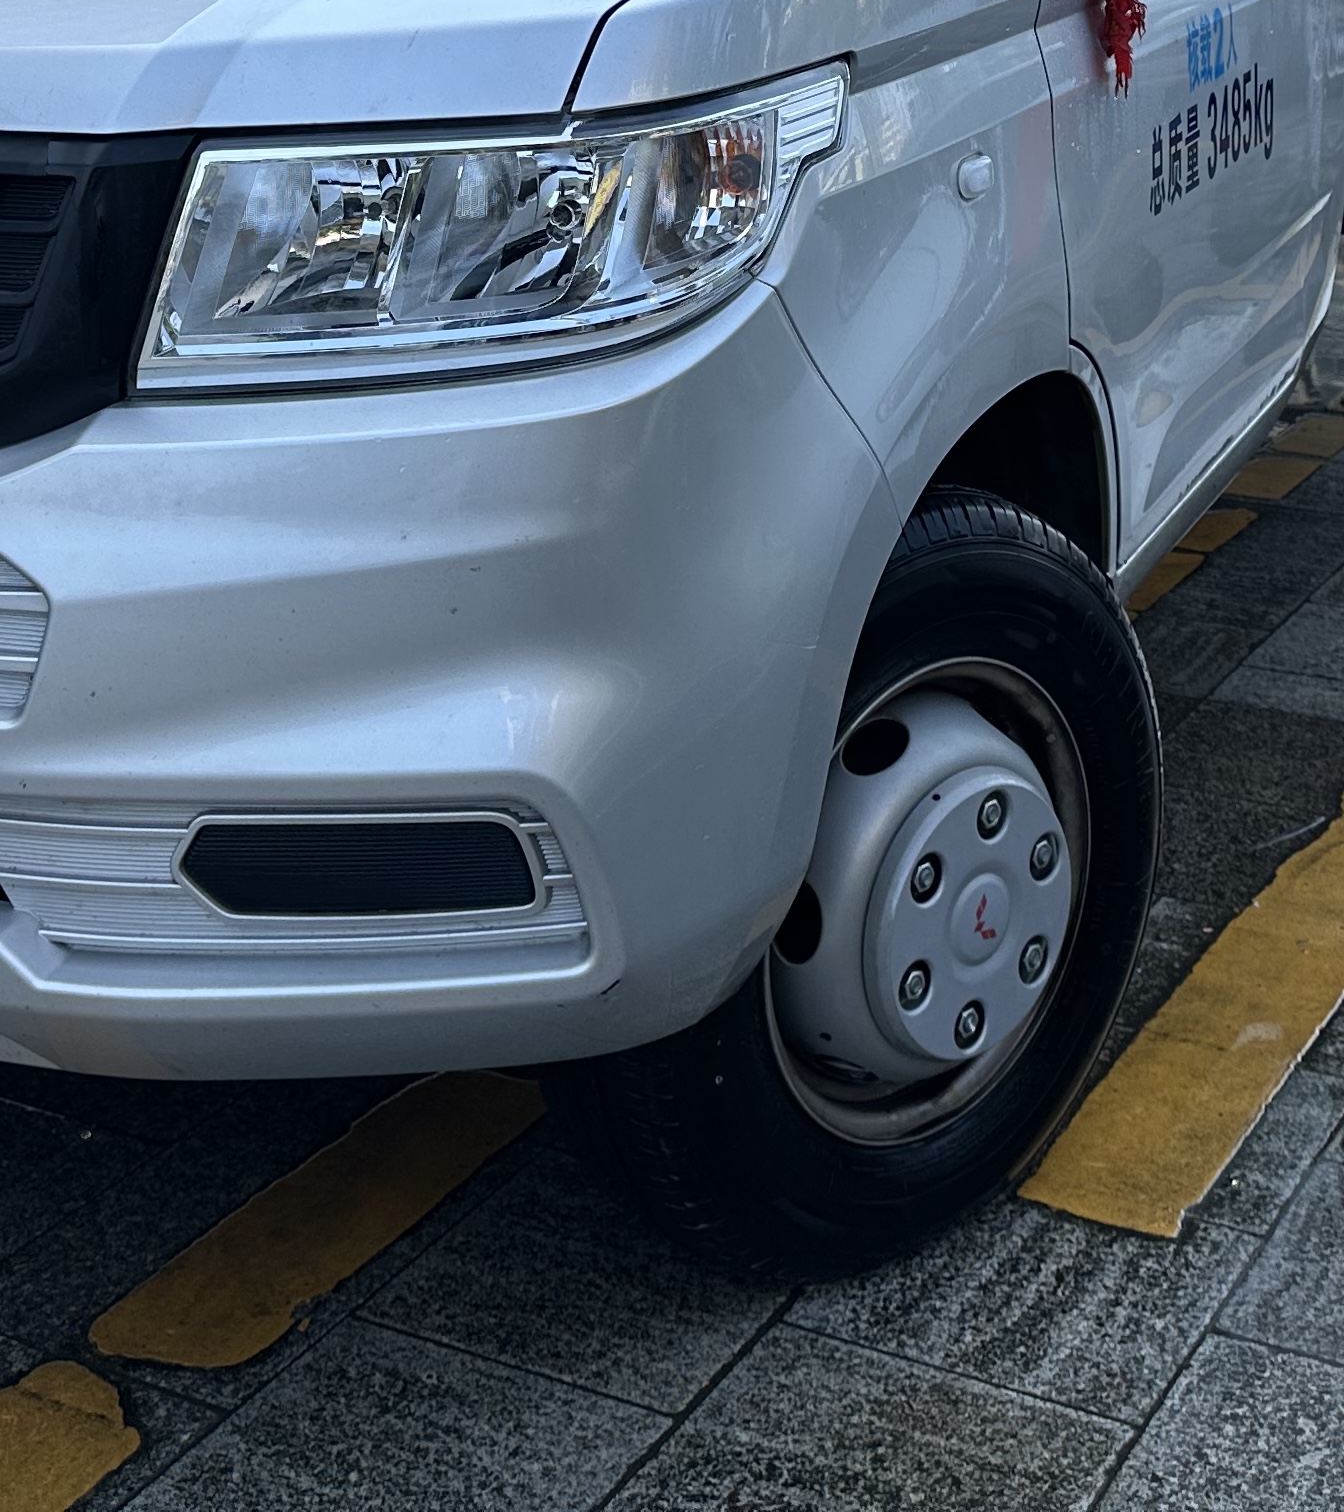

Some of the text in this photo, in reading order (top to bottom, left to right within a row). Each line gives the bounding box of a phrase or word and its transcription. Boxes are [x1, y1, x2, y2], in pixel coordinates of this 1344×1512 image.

[1185, 2, 1238, 92] 核载2人
[1149, 62, 1275, 217] 总质量 3485kg
